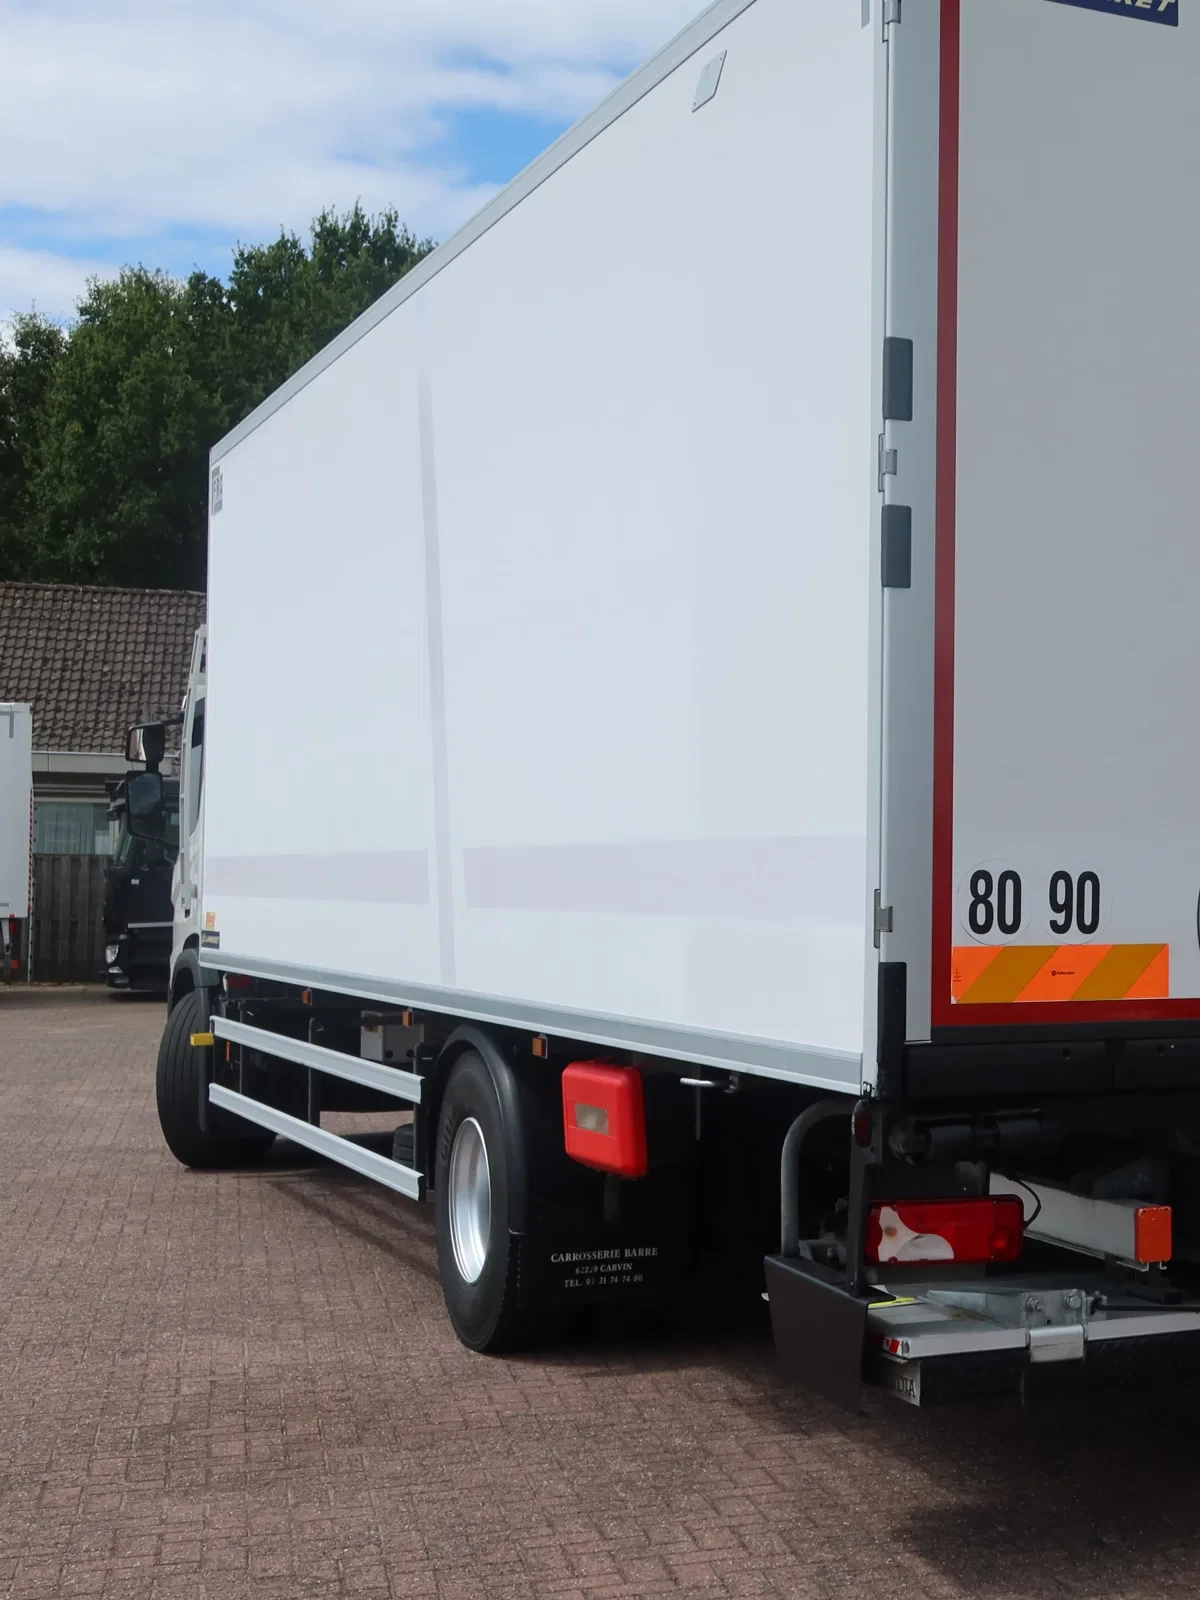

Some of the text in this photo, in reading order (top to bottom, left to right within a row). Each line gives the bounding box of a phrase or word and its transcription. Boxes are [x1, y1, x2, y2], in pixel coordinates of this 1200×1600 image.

[968, 869, 1022, 935] 80
[1049, 870, 1100, 935] 90
[550, 1247, 658, 1263] CARROSSERIE BARRE
[600, 1263, 633, 1273] CARVIN
